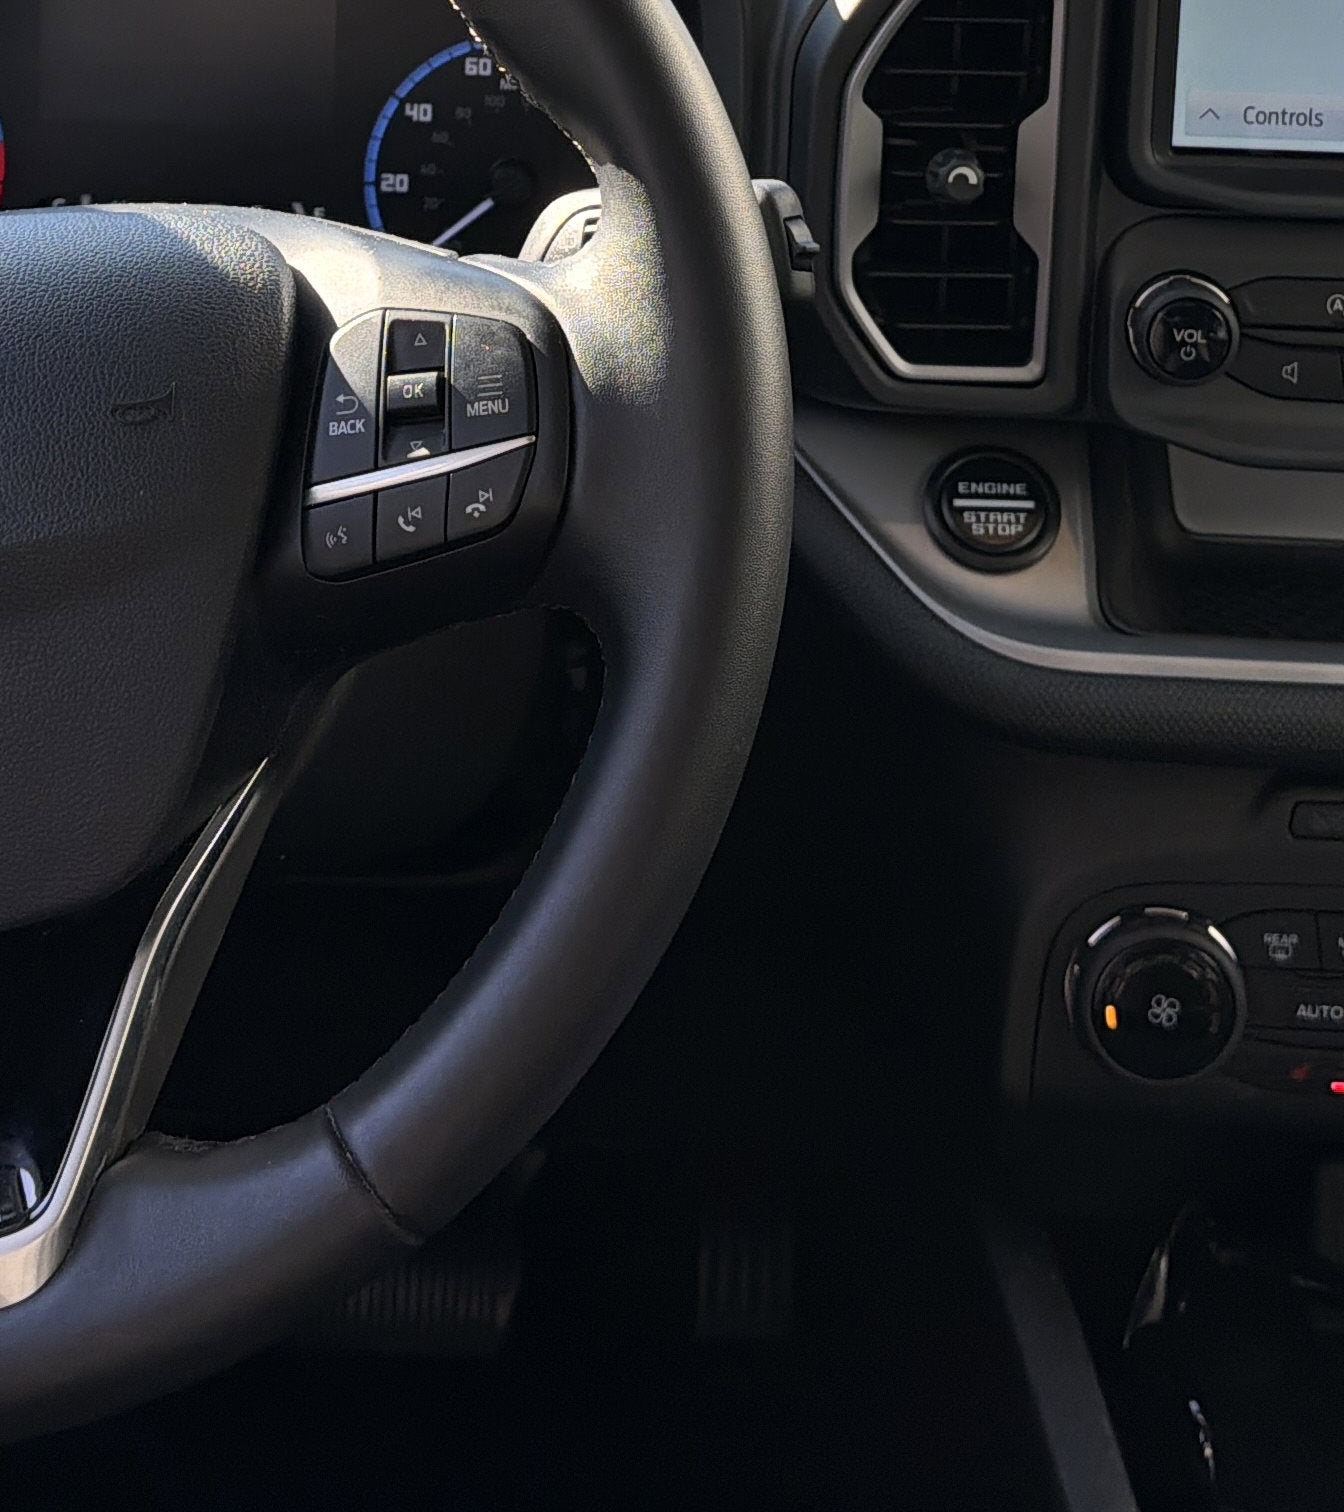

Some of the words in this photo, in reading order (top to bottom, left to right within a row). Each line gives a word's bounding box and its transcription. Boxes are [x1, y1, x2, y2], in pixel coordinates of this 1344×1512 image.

[464, 57, 492, 76] 60
[405, 102, 433, 122] 40
[1242, 104, 1324, 128] Controls
[380, 173, 410, 193] 20
[1173, 327, 1207, 344] VOL
[402, 382, 424, 400] OK
[466, 397, 510, 418] MENU
[328, 418, 365, 436] BACK
[957, 481, 1028, 496] ENGINE
[962, 510, 1028, 524] START
[971, 523, 1024, 536] STOP
[1263, 932, 1299, 947] REAR
